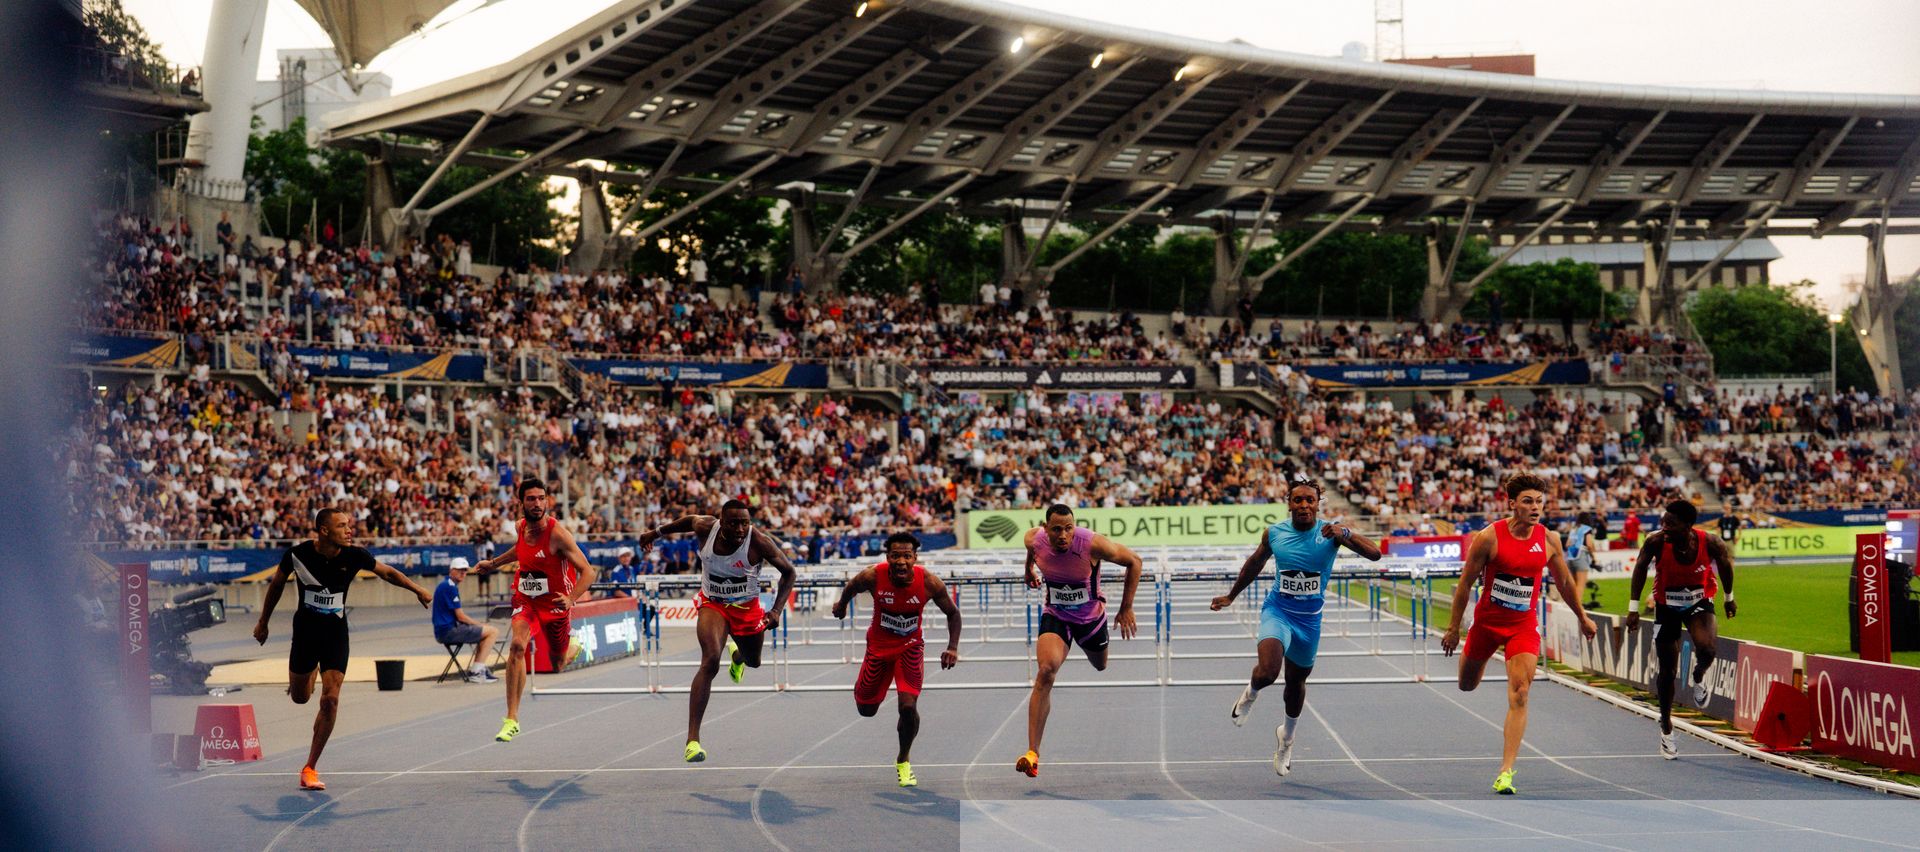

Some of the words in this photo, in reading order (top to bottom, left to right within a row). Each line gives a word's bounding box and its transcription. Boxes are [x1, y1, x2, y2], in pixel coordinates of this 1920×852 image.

[962, 372, 1002, 382] RUNNERS
[1003, 372, 1028, 382] PARIS
[1060, 372, 1093, 382] ADIDAS
[1094, 372, 1135, 383] RUNNERS
[1136, 372, 1161, 383] PARIS
[1134, 513, 1277, 536] ATHLETICS
[1424, 543, 1461, 558] 13.00
[522, 581, 542, 591] LLOPIS
[709, 583, 747, 595] HOLLOWAY
[1282, 579, 1319, 591] BEARD
[1493, 583, 1532, 599] CUNNINGHAM
[314, 594, 335, 605] BRITT
[1055, 590, 1084, 601] JOSEPH
[1863, 564, 1878, 627] OMEGA
[128, 593, 142, 655] OMEGA
[1841, 687, 1916, 759] OMEGA
